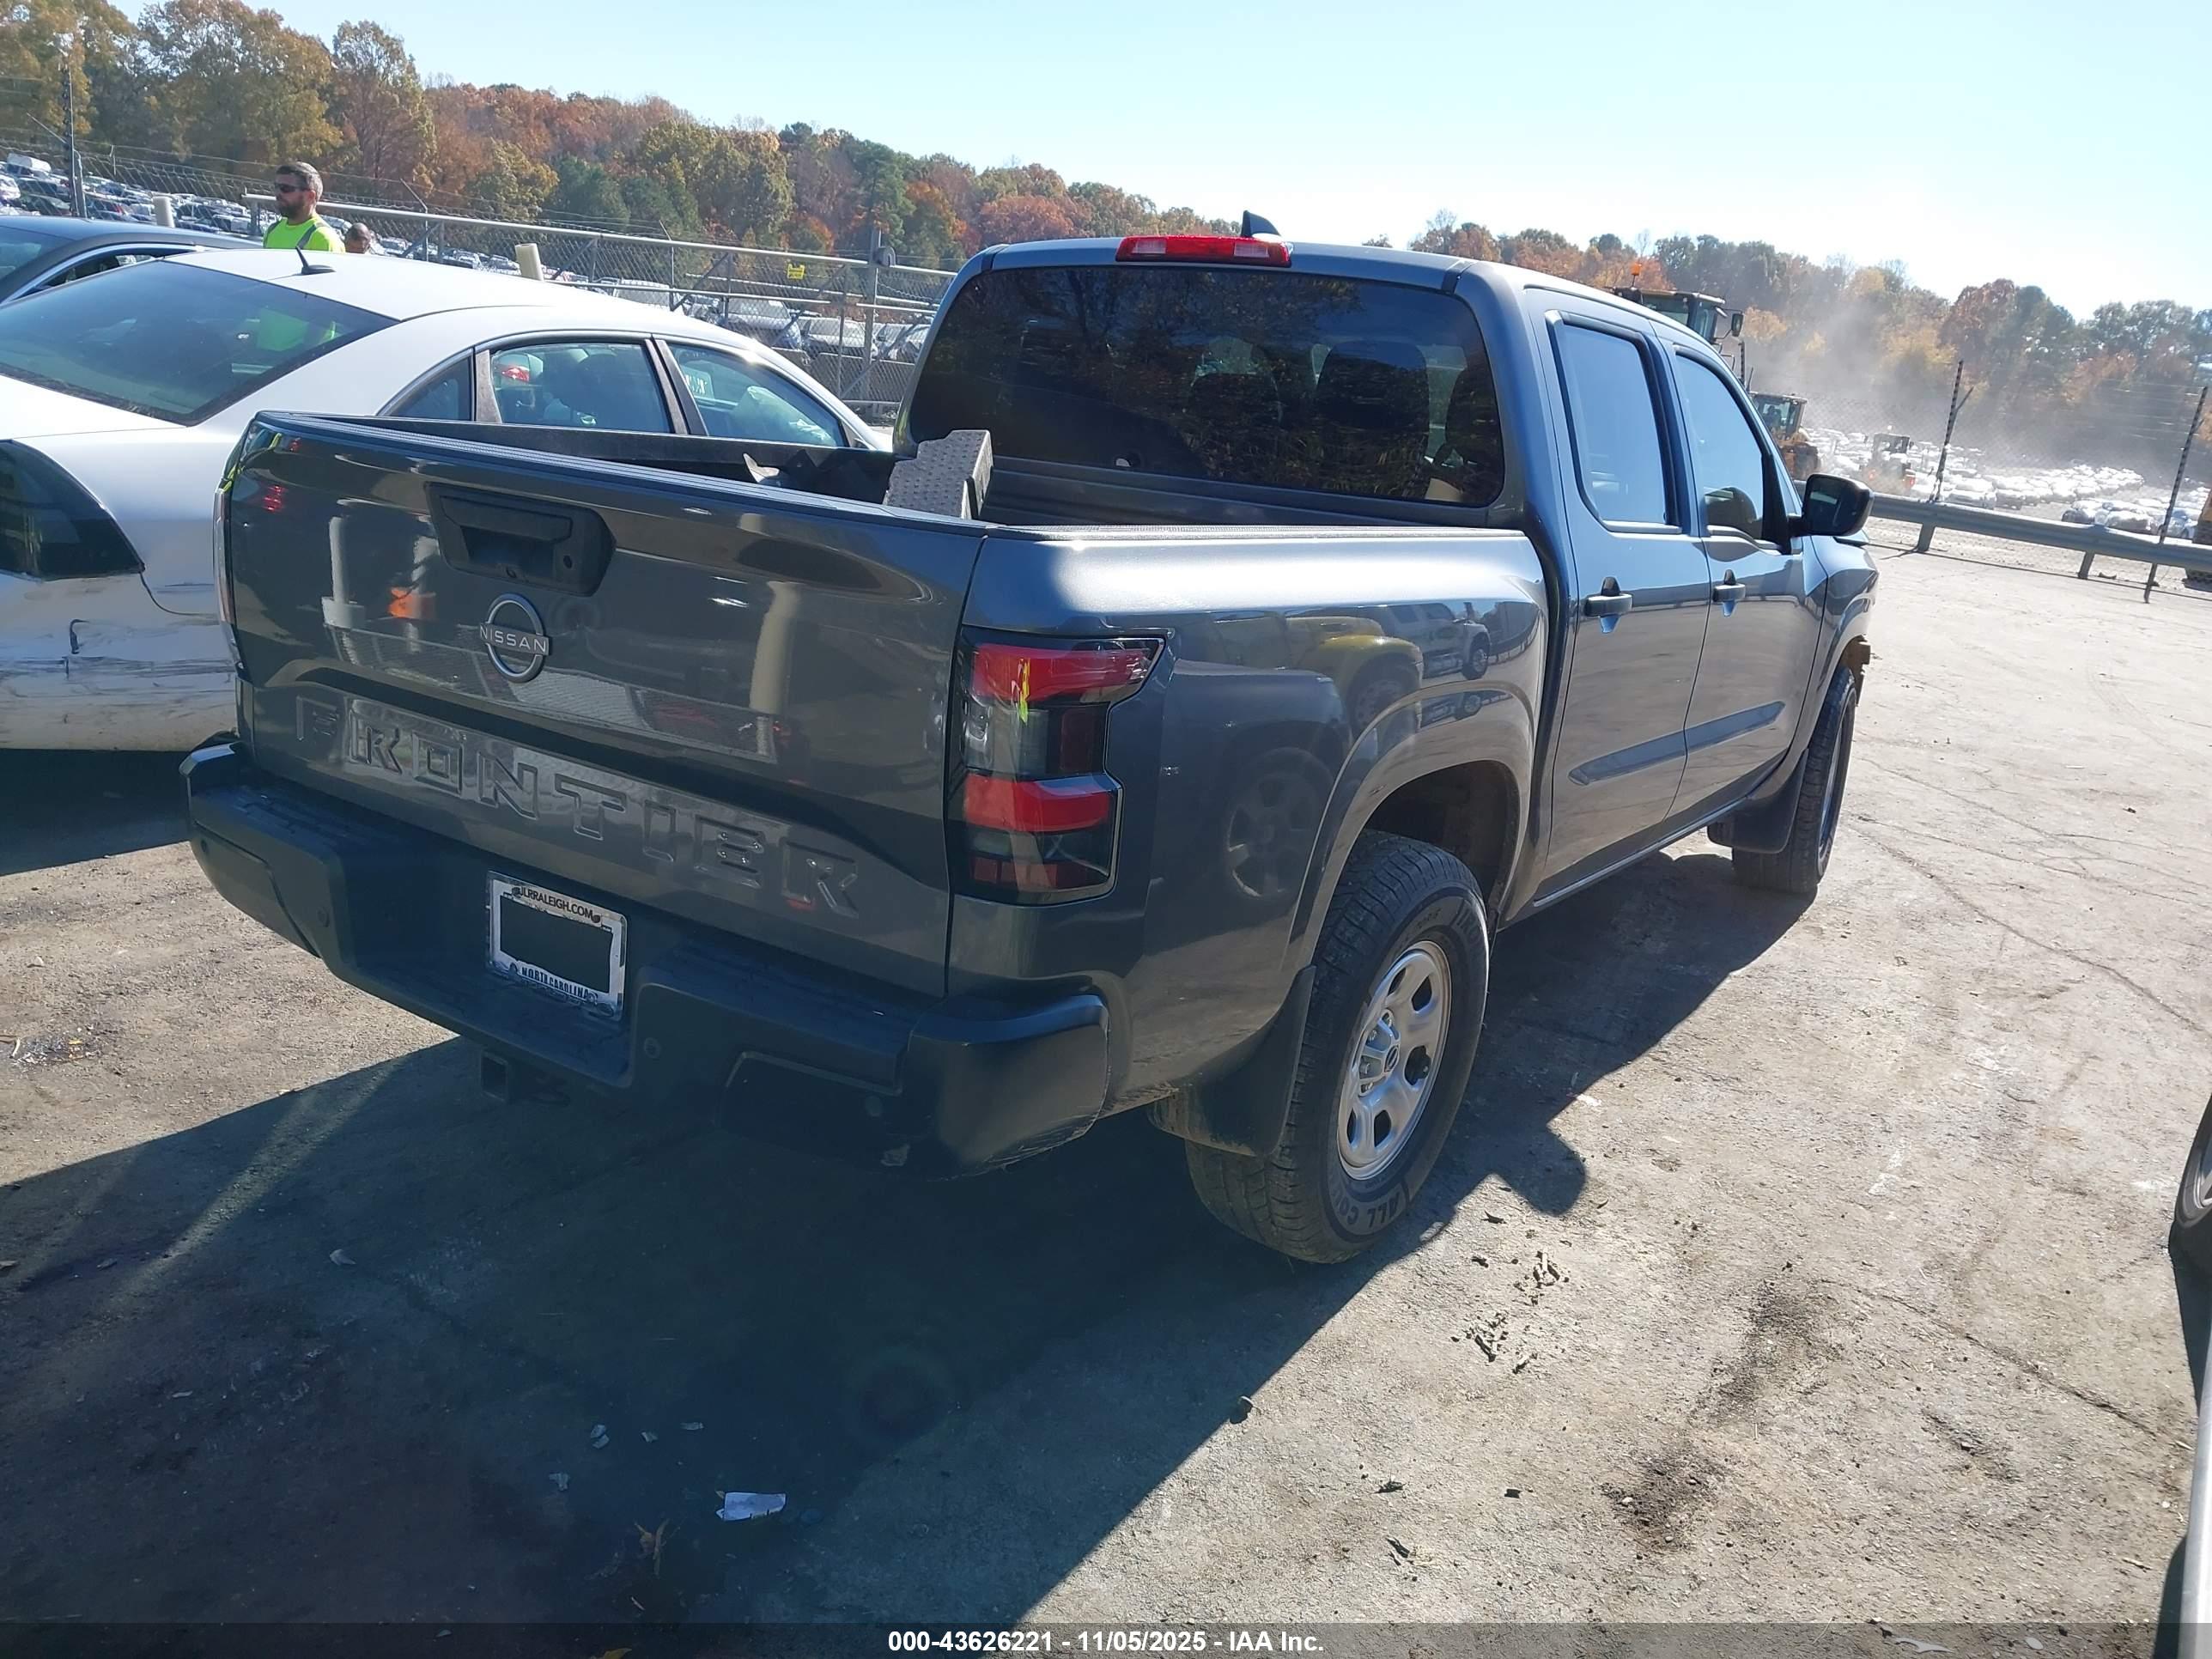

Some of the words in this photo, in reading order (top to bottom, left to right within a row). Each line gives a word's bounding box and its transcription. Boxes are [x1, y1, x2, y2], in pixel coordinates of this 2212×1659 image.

[480, 624, 546, 653] NISSAN
[295, 694, 860, 920] FRONTIER
[522, 966, 548, 983] NORTH
[550, 976, 590, 1000] CAROLINA
